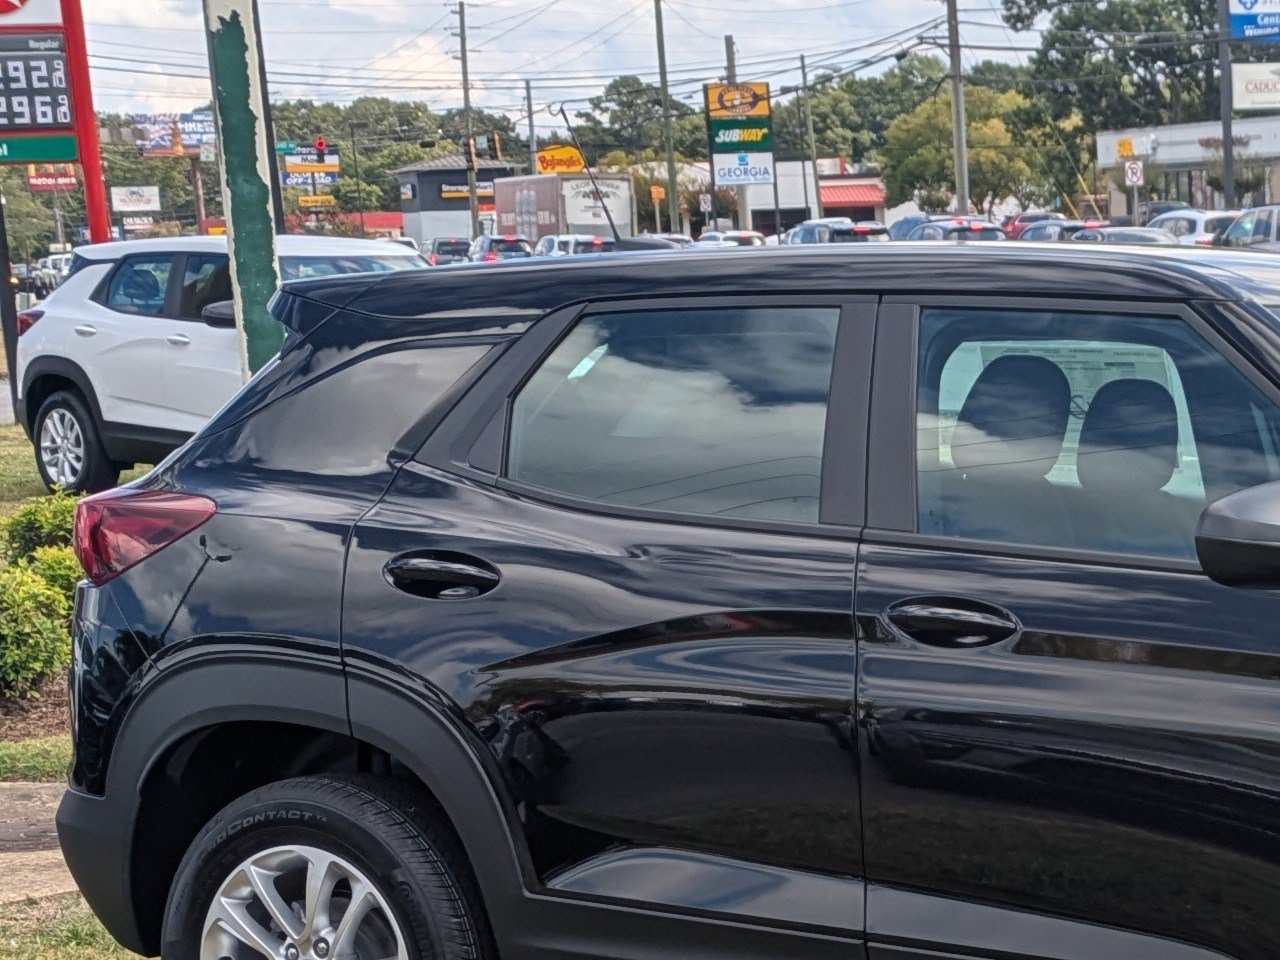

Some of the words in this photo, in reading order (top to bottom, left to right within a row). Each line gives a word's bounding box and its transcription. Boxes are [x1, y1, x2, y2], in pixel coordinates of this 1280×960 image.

[0, 60, 50, 89] 92
[714, 128, 767, 144] SUBWAY
[538, 155, 581, 170] Bojangles
[718, 167, 771, 178] GEORGIA
